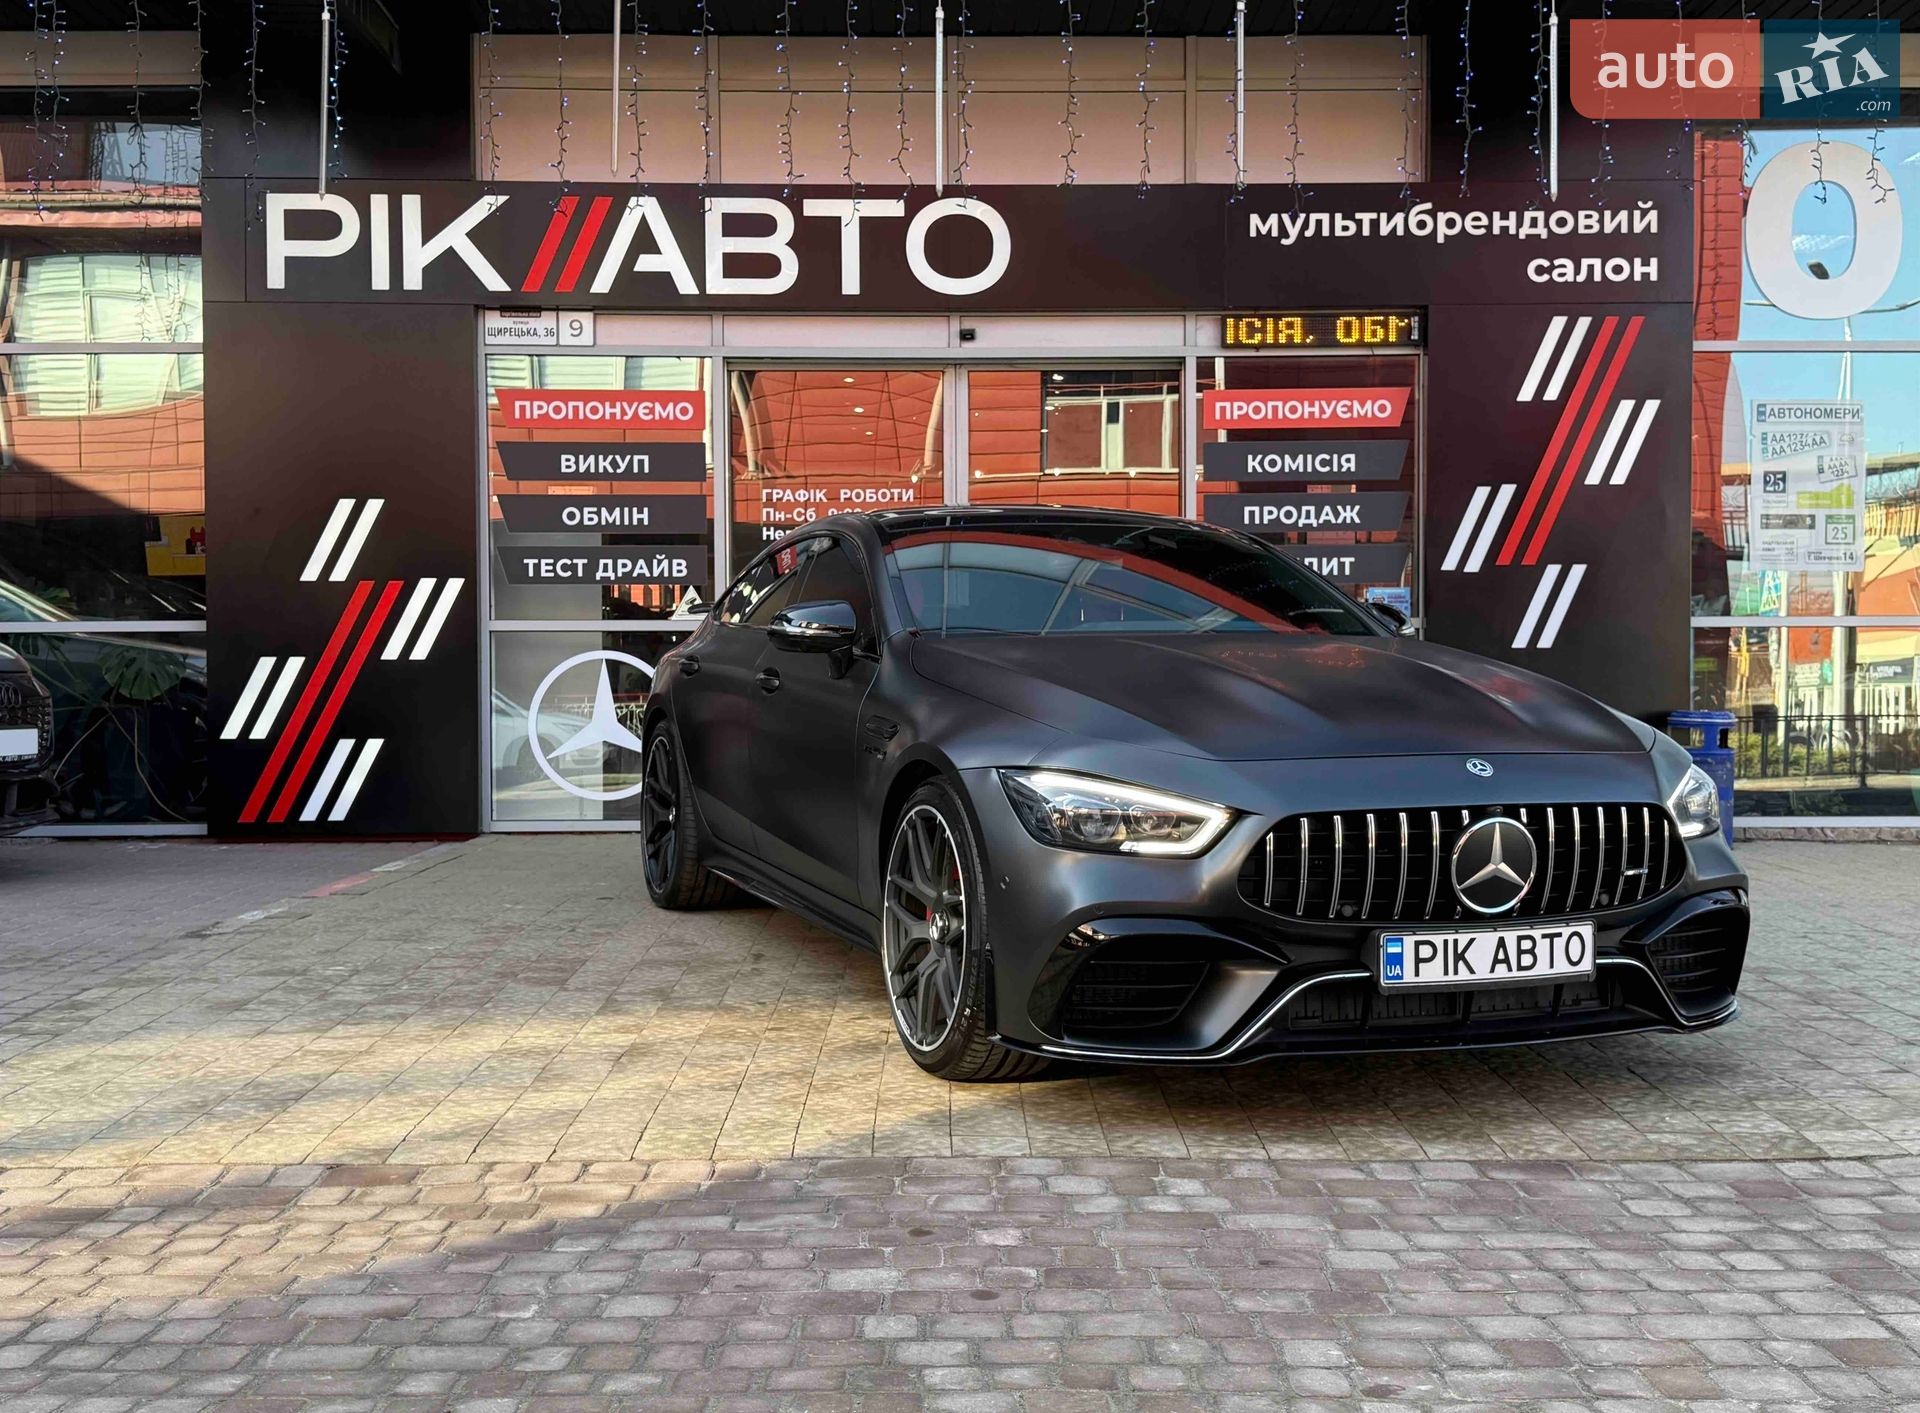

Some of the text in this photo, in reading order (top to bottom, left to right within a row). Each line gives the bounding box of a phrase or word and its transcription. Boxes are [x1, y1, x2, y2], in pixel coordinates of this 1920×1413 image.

[1249, 200, 1659, 245] мультибрендовий
[266, 192, 1012, 296] РІК АВТО
[1527, 256, 1659, 284] салон
[487, 327, 555, 338] ЩИРЕЦЬКА, 36
[569, 319, 583, 338] 9
[514, 400, 694, 421] ПРОПОНУЄМО
[1215, 399, 1392, 420] ПРОПОНУЄМО
[1767, 407, 1860, 420] АВТОНОМЕРИ
[560, 454, 650, 474] ВИКУП
[1247, 453, 1356, 473] КОМІСІЯ
[1765, 473, 1784, 492] 25
[762, 488, 914, 503] ГРАФІК РОБОТИ
[561, 506, 650, 526] ОБМІН
[762, 507, 817, 522] Пн-Сб
[1243, 504, 1361, 527] ПРОДАЖ
[1832, 526, 1848, 541] 25
[1843, 551, 1854, 561] 14
[523, 554, 688, 581] ТЕСТ ДРАЙВ
[1297, 557, 1356, 576] ДИТ
[1413, 930, 1586, 978] РІК АВТО
[1387, 965, 1402, 977] UA
